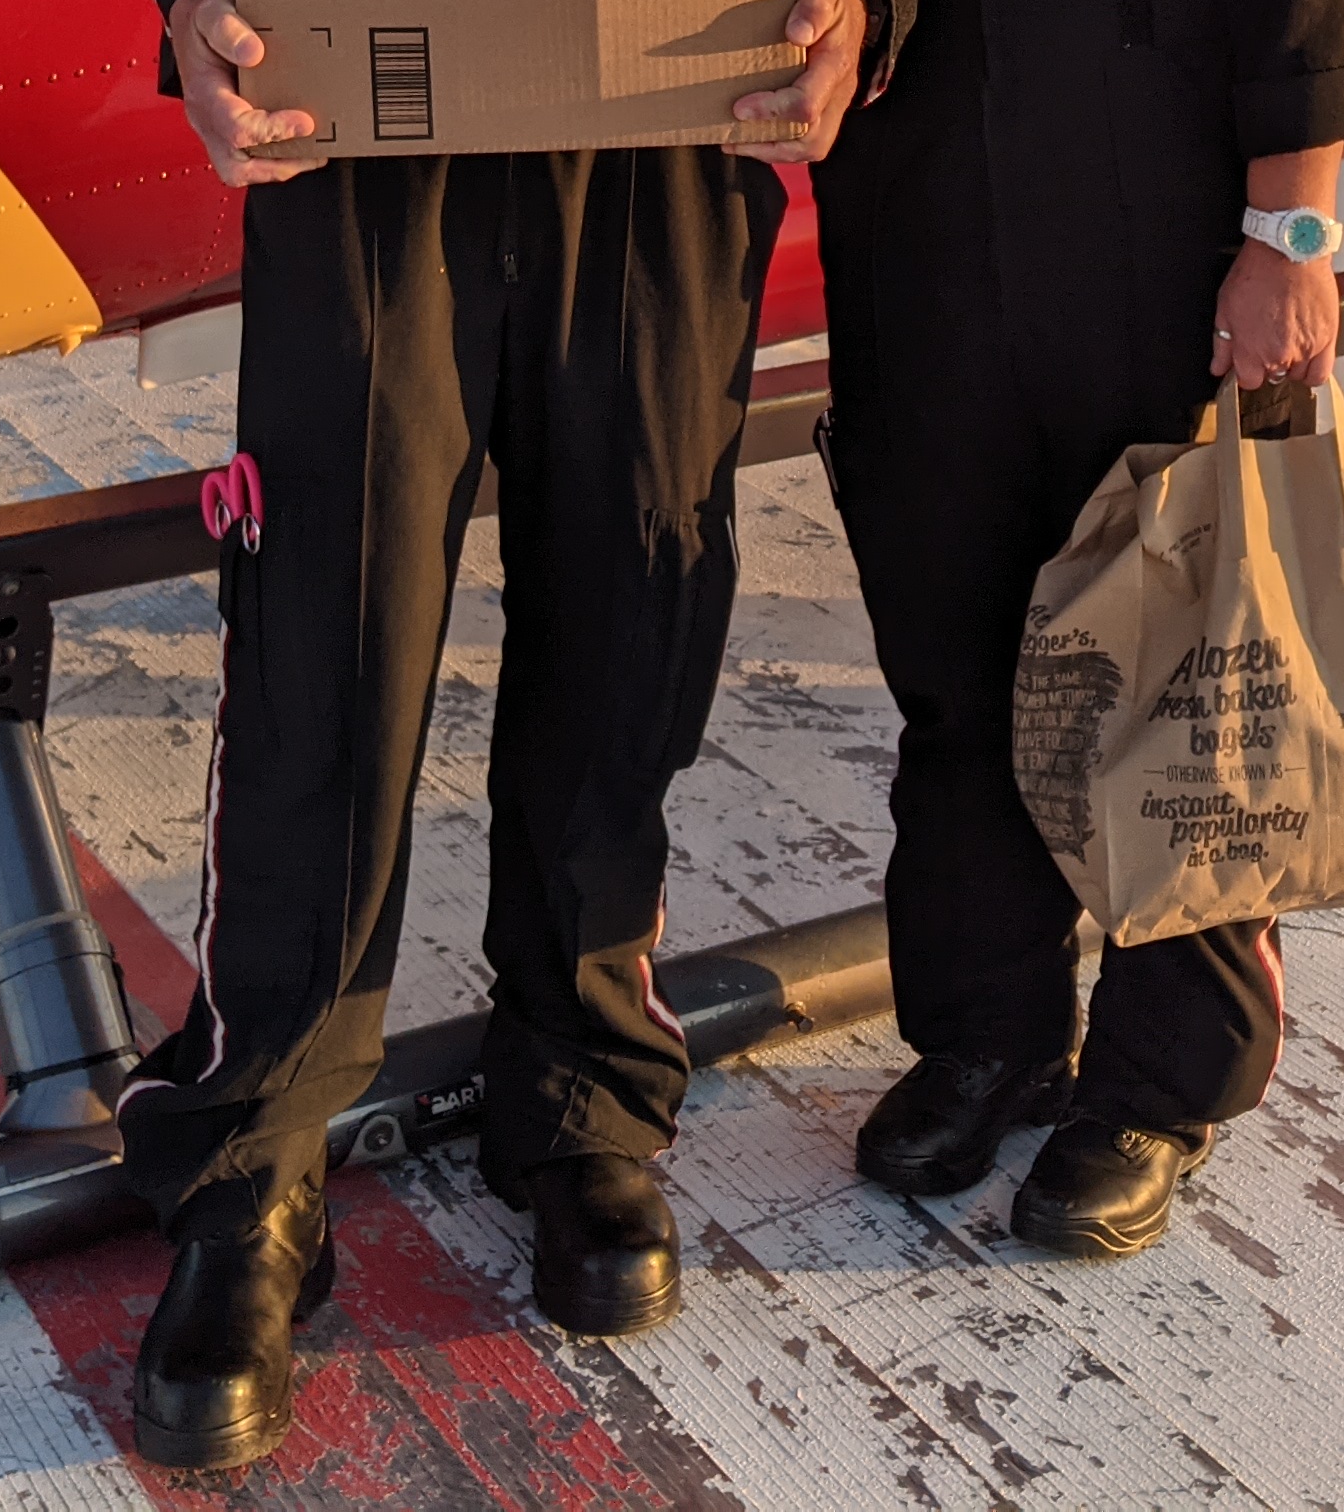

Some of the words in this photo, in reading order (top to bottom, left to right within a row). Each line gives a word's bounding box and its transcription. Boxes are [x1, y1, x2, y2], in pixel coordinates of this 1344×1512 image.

[1169, 646, 1197, 686] A
[1214, 673, 1298, 716] baked
[1190, 716, 1277, 758] bagels
[1166, 764, 1225, 784] OTHERWISE
[1228, 763, 1266, 781] KNOWN
[1269, 763, 1283, 779] AS
[1140, 790, 1236, 820] instant
[1168, 802, 1309, 849] popularity
[1186, 846, 1207, 868] in
[1209, 845, 1225, 864] a
[1226, 840, 1270, 863] bag.
